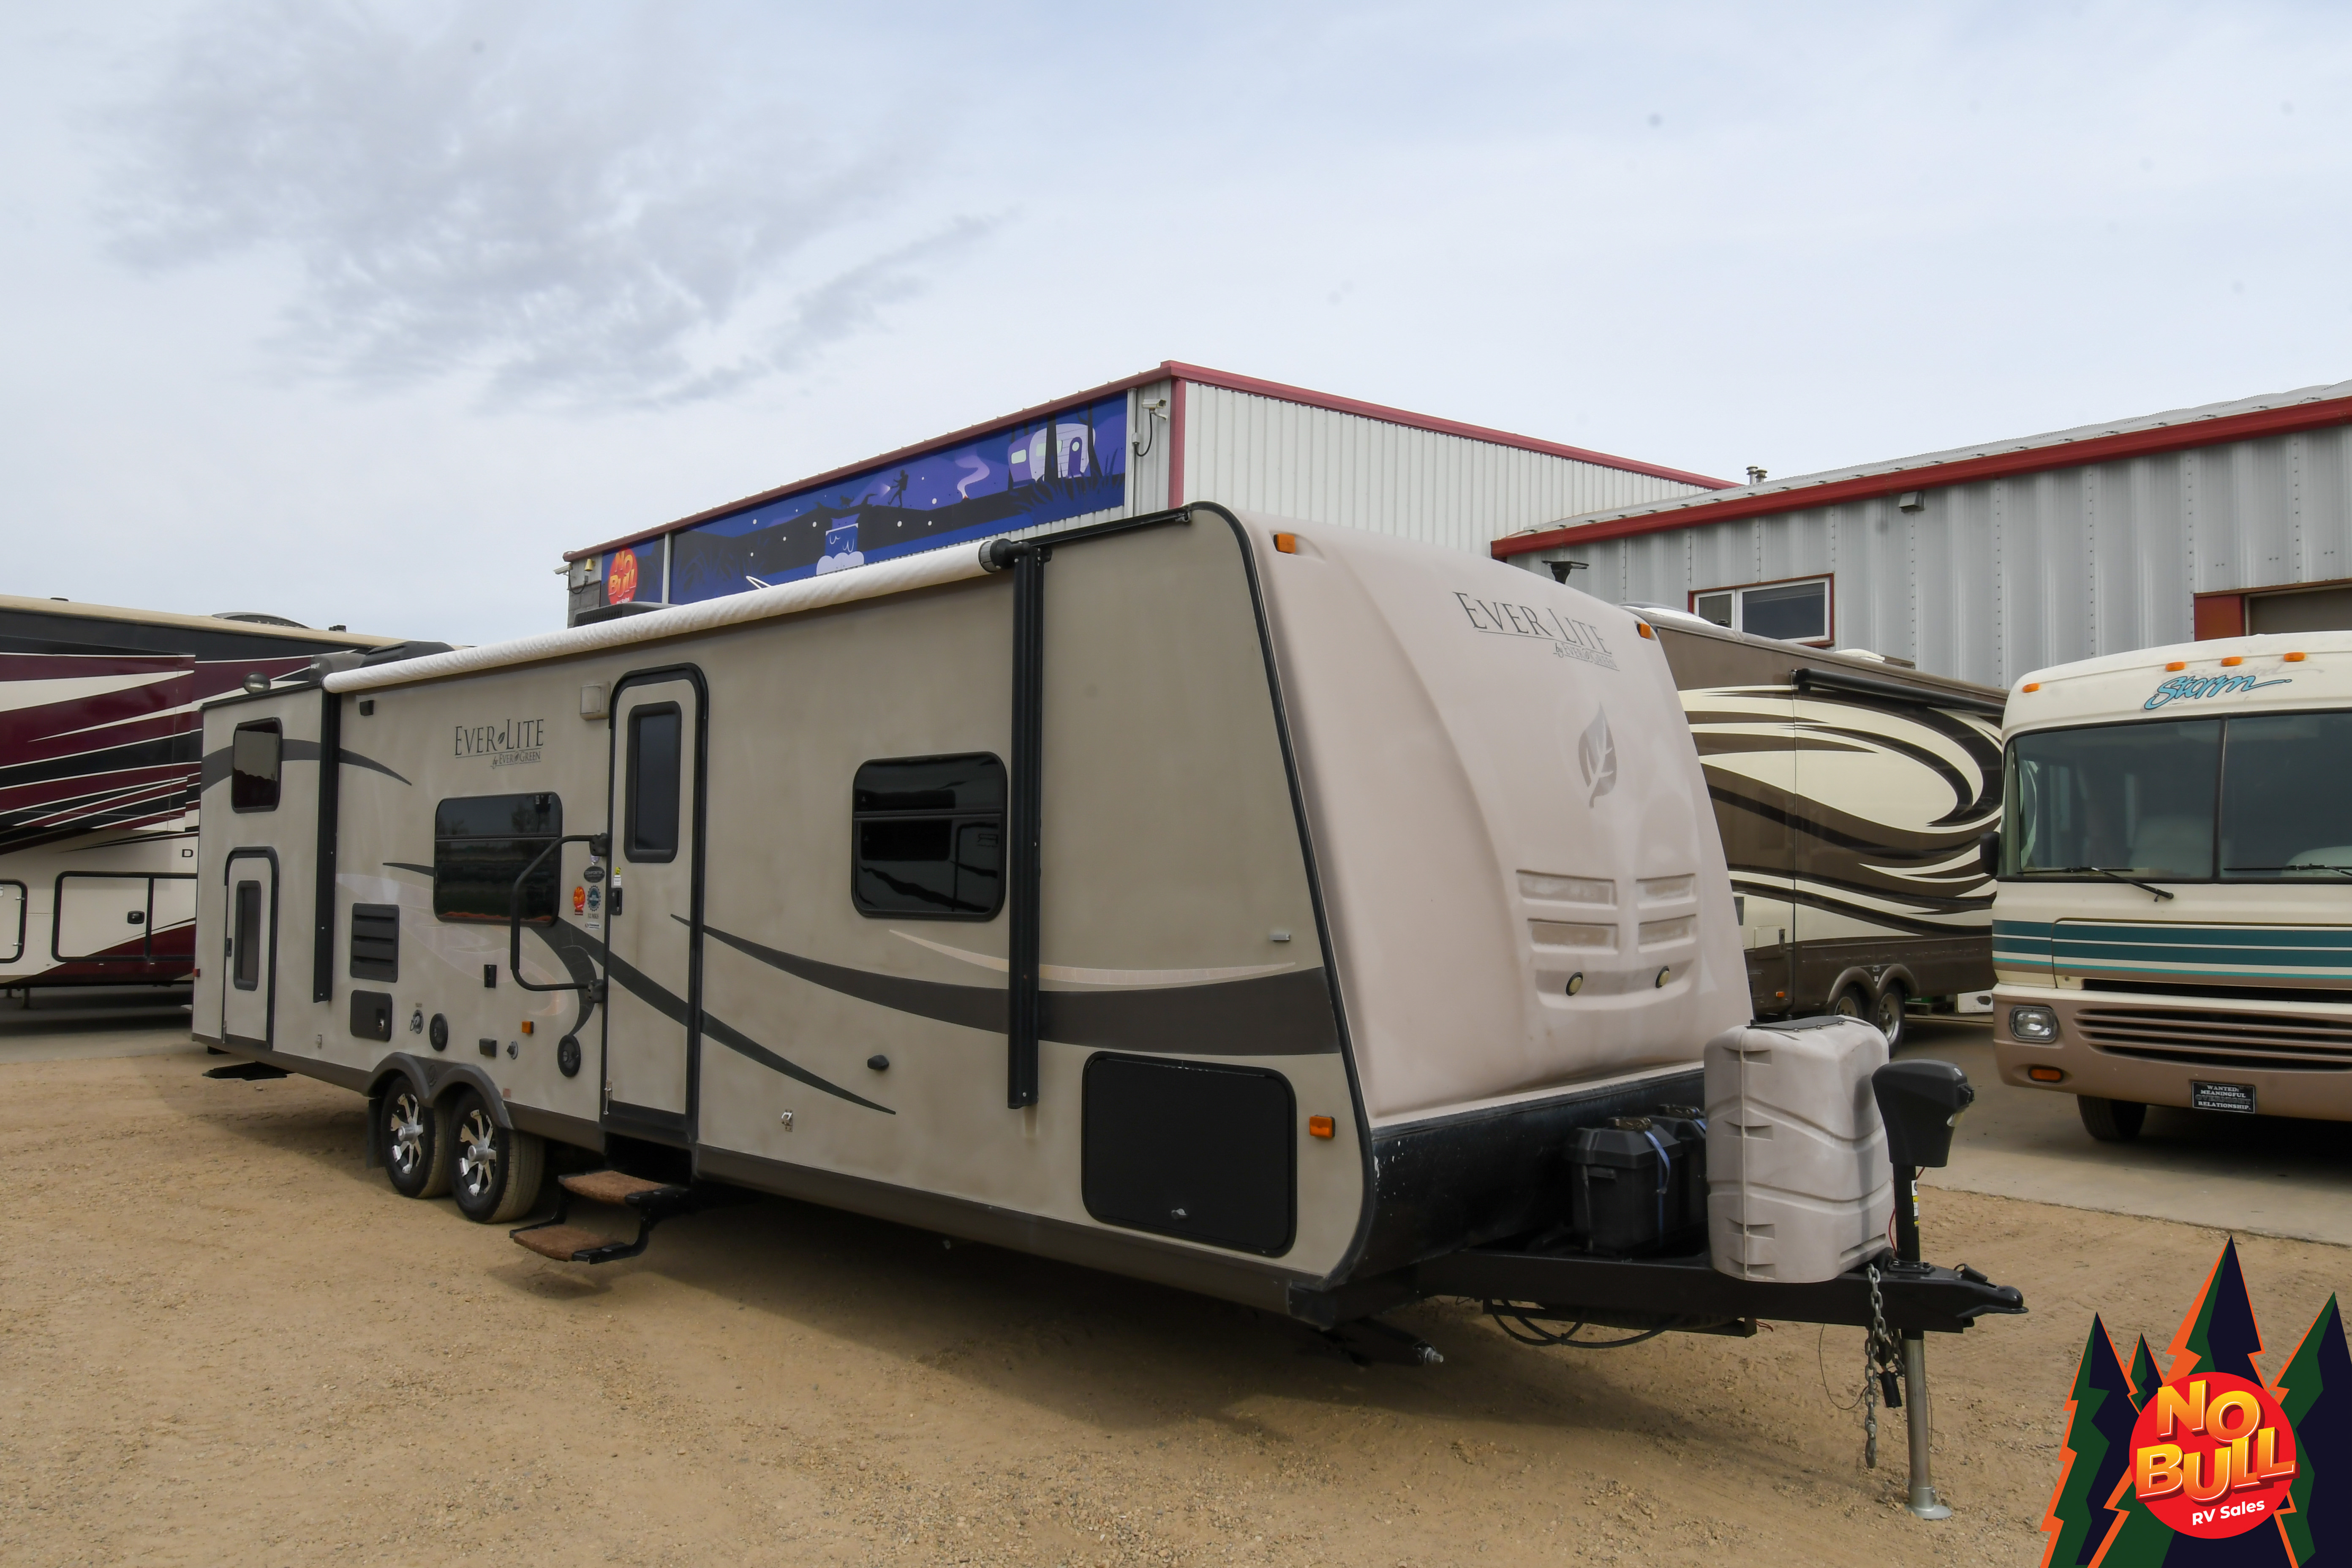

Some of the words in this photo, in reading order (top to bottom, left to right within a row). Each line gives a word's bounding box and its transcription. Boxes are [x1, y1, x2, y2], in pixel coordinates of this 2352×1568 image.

[615, 550, 633, 575] NO
[608, 569, 636, 597] BULL
[1452, 591, 1554, 637] EVER
[1546, 607, 1612, 655] LITE
[1554, 642, 1564, 658] by
[2144, 675, 2292, 710] Storm
[455, 726, 498, 756] EVER
[506, 719, 544, 750] LITE
[490, 756, 498, 769] by
[499, 753, 514, 764] EVER
[520, 751, 541, 762] GREEN
[2195, 1094, 2251, 1105] OVERNIGHT
[2200, 1089, 2246, 1098] MEANINGFUL
[2198, 1101, 2251, 1110] RELATIONSHIP.
